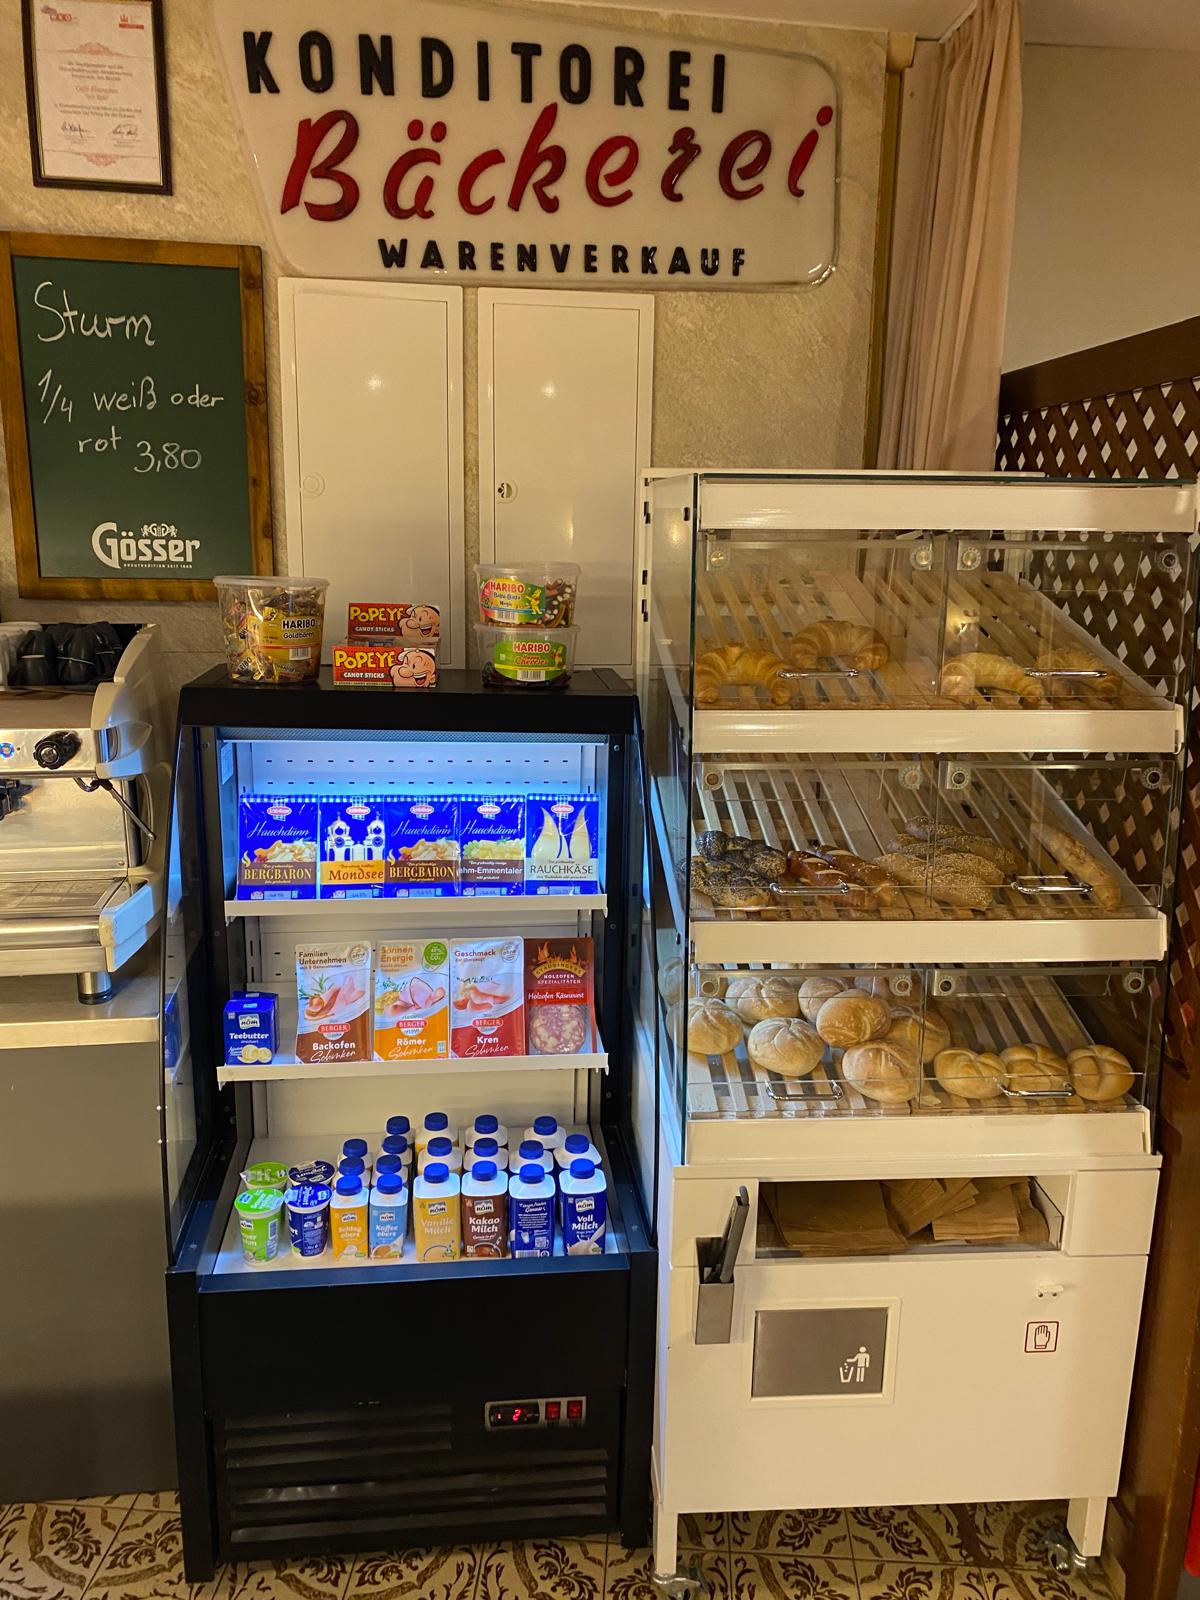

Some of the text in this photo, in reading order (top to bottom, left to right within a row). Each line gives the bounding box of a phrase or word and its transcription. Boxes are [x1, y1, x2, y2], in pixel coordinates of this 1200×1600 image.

[242, 31, 727, 114] KONDITOREI
[280, 101, 835, 222] Bäckerei
[377, 238, 748, 277] WARENVERKAUF
[34, 281, 156, 347] Sturm
[37, 369, 225, 425] 1/4 weiß oder
[77, 425, 203, 474] rot 3,80
[91, 521, 201, 569] Gösser
[490, 581, 525, 594] HARIBO
[349, 606, 403, 622] POPEYE
[282, 618, 316, 630] HARIBO
[513, 641, 551, 653] HARIBO
[334, 650, 397, 669] POPEYE
[514, 656, 549, 665] Cherries
[246, 820, 311, 839] Hauchdünn
[391, 819, 452, 837] Hauchdünn
[459, 819, 517, 836] Hauchdünn
[244, 868, 312, 880] BERGBARON
[389, 866, 456, 878] BERGBARON
[459, 866, 524, 875] ahm-Emmentaler
[529, 863, 593, 874] RAUCHKÄSE
[328, 868, 384, 881] Mondsee
[381, 945, 413, 954] Sonnen
[454, 949, 497, 957] Geschmack
[299, 957, 347, 965] Unternehmen
[381, 954, 414, 963] Energie
[528, 991, 585, 1001] Holzofen Käsewurst
[240, 1018, 258, 1026] nöm
[229, 1032, 270, 1040] Teebutter
[477, 1035, 499, 1044] Kren
[312, 1041, 356, 1051] Backofen
[396, 1038, 427, 1046] Römer
[420, 1217, 454, 1226] Vanille
[469, 1216, 500, 1225] Kakao
[577, 1214, 594, 1222] Voll
[424, 1225, 451, 1234] Milch
[471, 1224, 499, 1233] Milch
[571, 1222, 598, 1231] Milch
